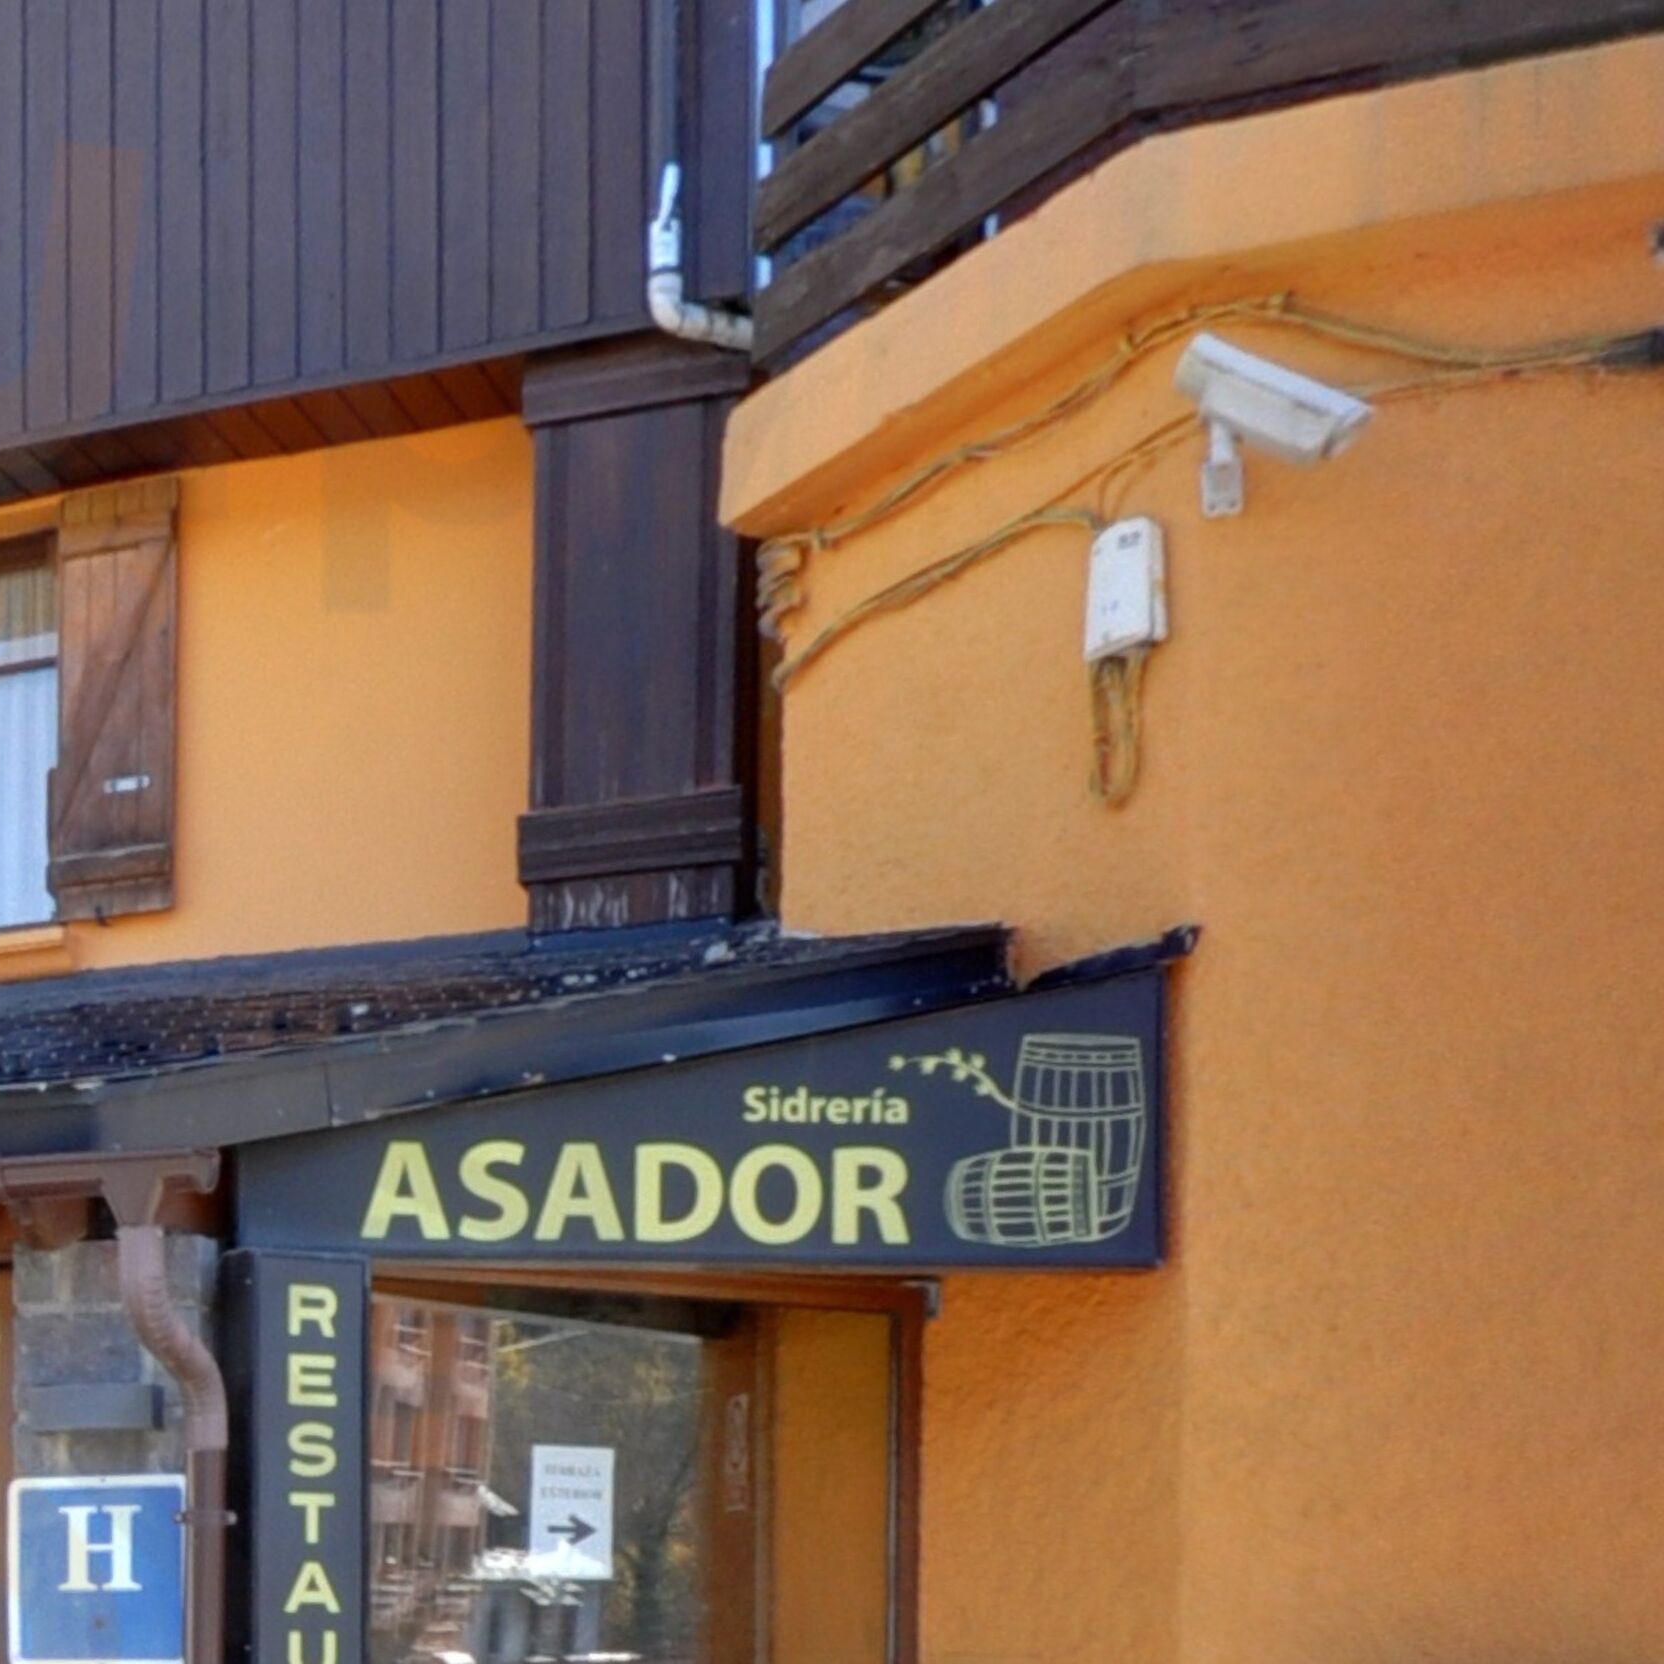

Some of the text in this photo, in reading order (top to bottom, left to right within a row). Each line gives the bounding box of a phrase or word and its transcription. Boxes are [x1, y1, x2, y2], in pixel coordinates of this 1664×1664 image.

[742, 1086, 910, 1126] Sidrería
[360, 1140, 911, 1246] ASADOR
[57, 1503, 143, 1592] H
